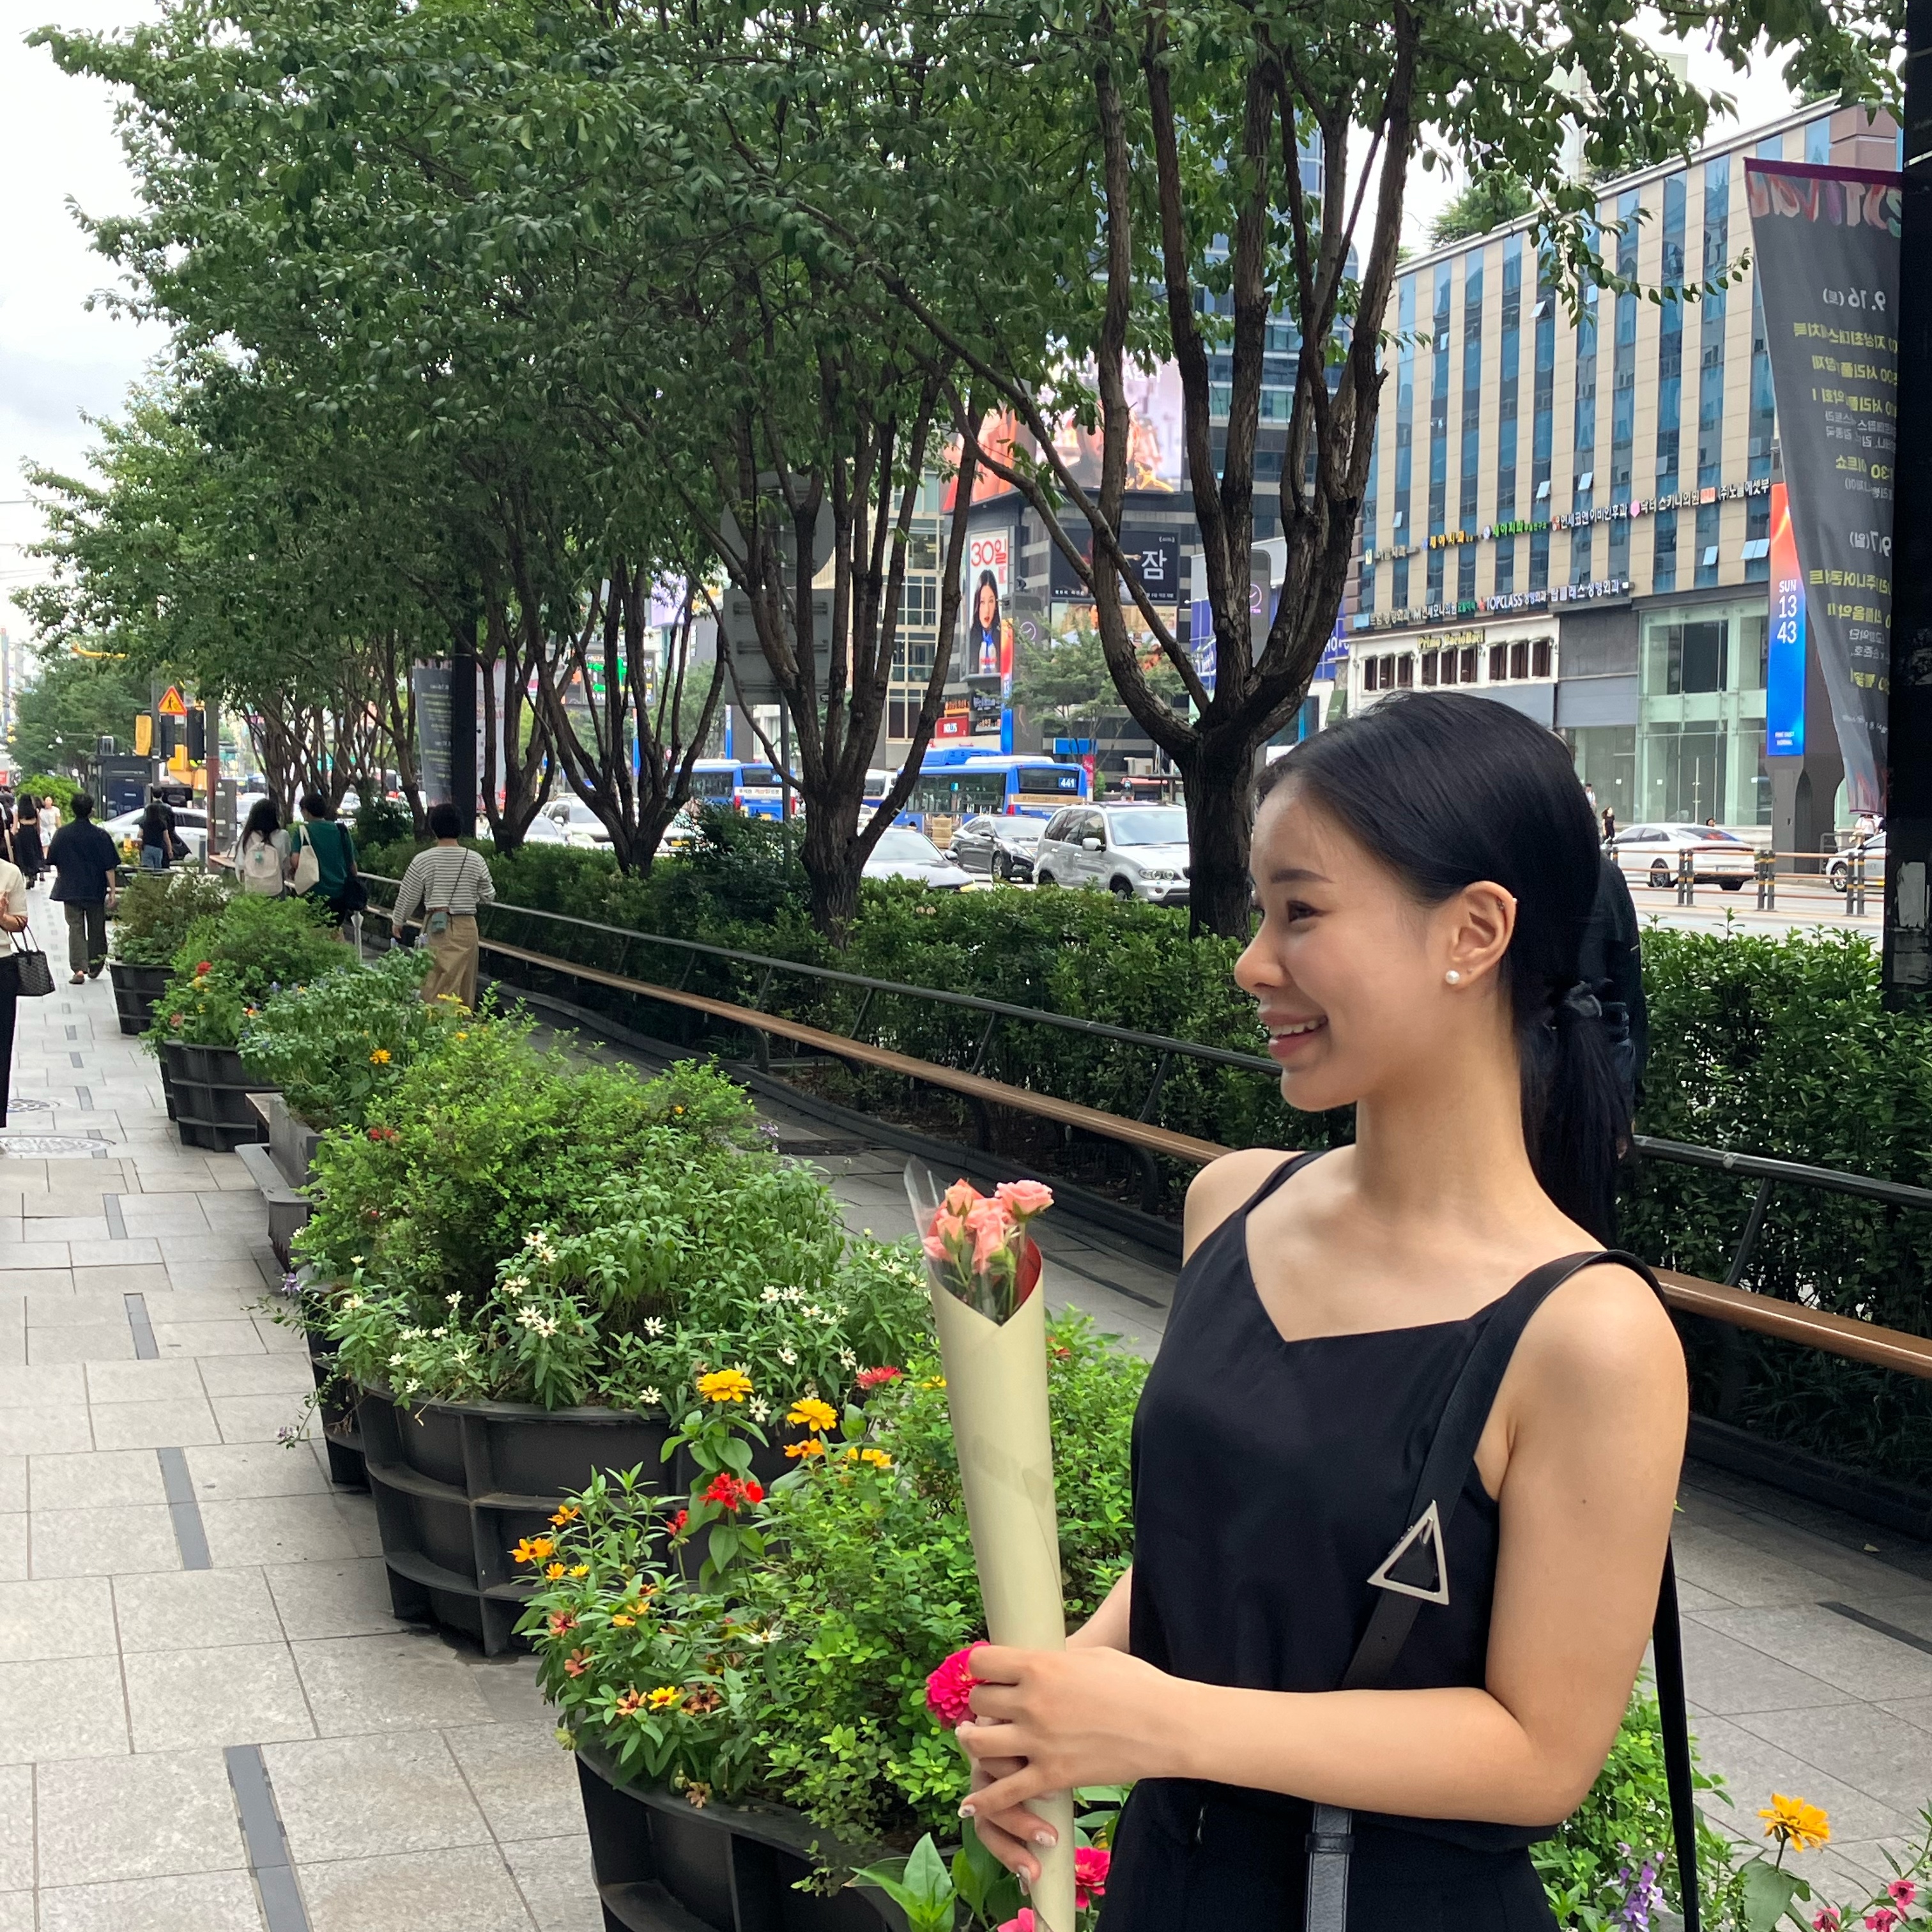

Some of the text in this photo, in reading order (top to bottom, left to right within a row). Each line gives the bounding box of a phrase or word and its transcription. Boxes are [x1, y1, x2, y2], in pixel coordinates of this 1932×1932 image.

[971, 538, 1007, 567] 30일
[1141, 549, 1168, 580] 잠
[1779, 579, 1797, 593] SUN
[1486, 593, 1523, 610] TOPCLASS
[1779, 595, 1797, 618] 13
[1777, 621, 1797, 644] 43
